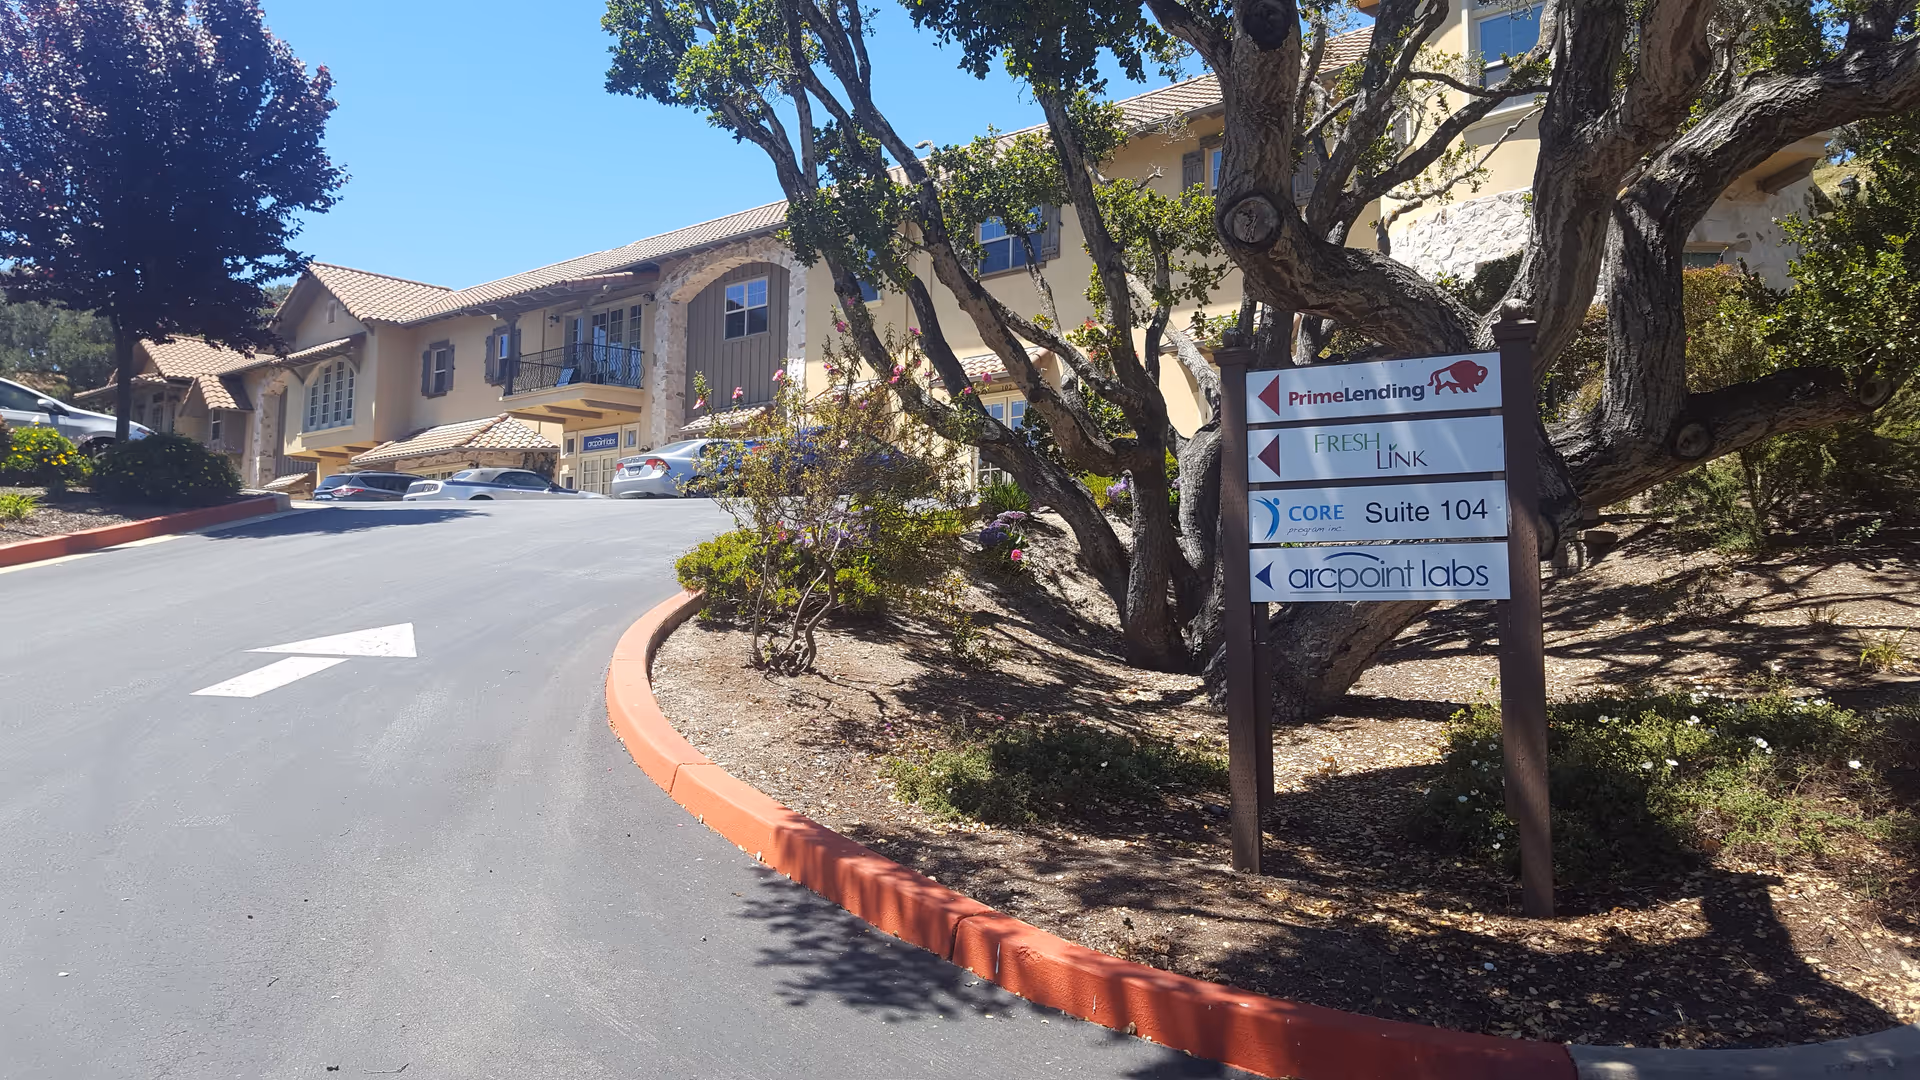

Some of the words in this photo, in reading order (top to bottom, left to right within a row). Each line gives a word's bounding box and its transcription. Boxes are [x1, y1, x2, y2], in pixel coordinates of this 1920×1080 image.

[1288, 384, 1425, 406] PrimeLending
[1314, 432, 1380, 453] FRESH
[1288, 504, 1345, 522] CORE
[1365, 501, 1430, 523] Suite
[1440, 498, 1489, 521] 104
[1287, 526, 1325, 536] program
[1288, 559, 1415, 593] arcpoint
[1422, 558, 1489, 587] labs
